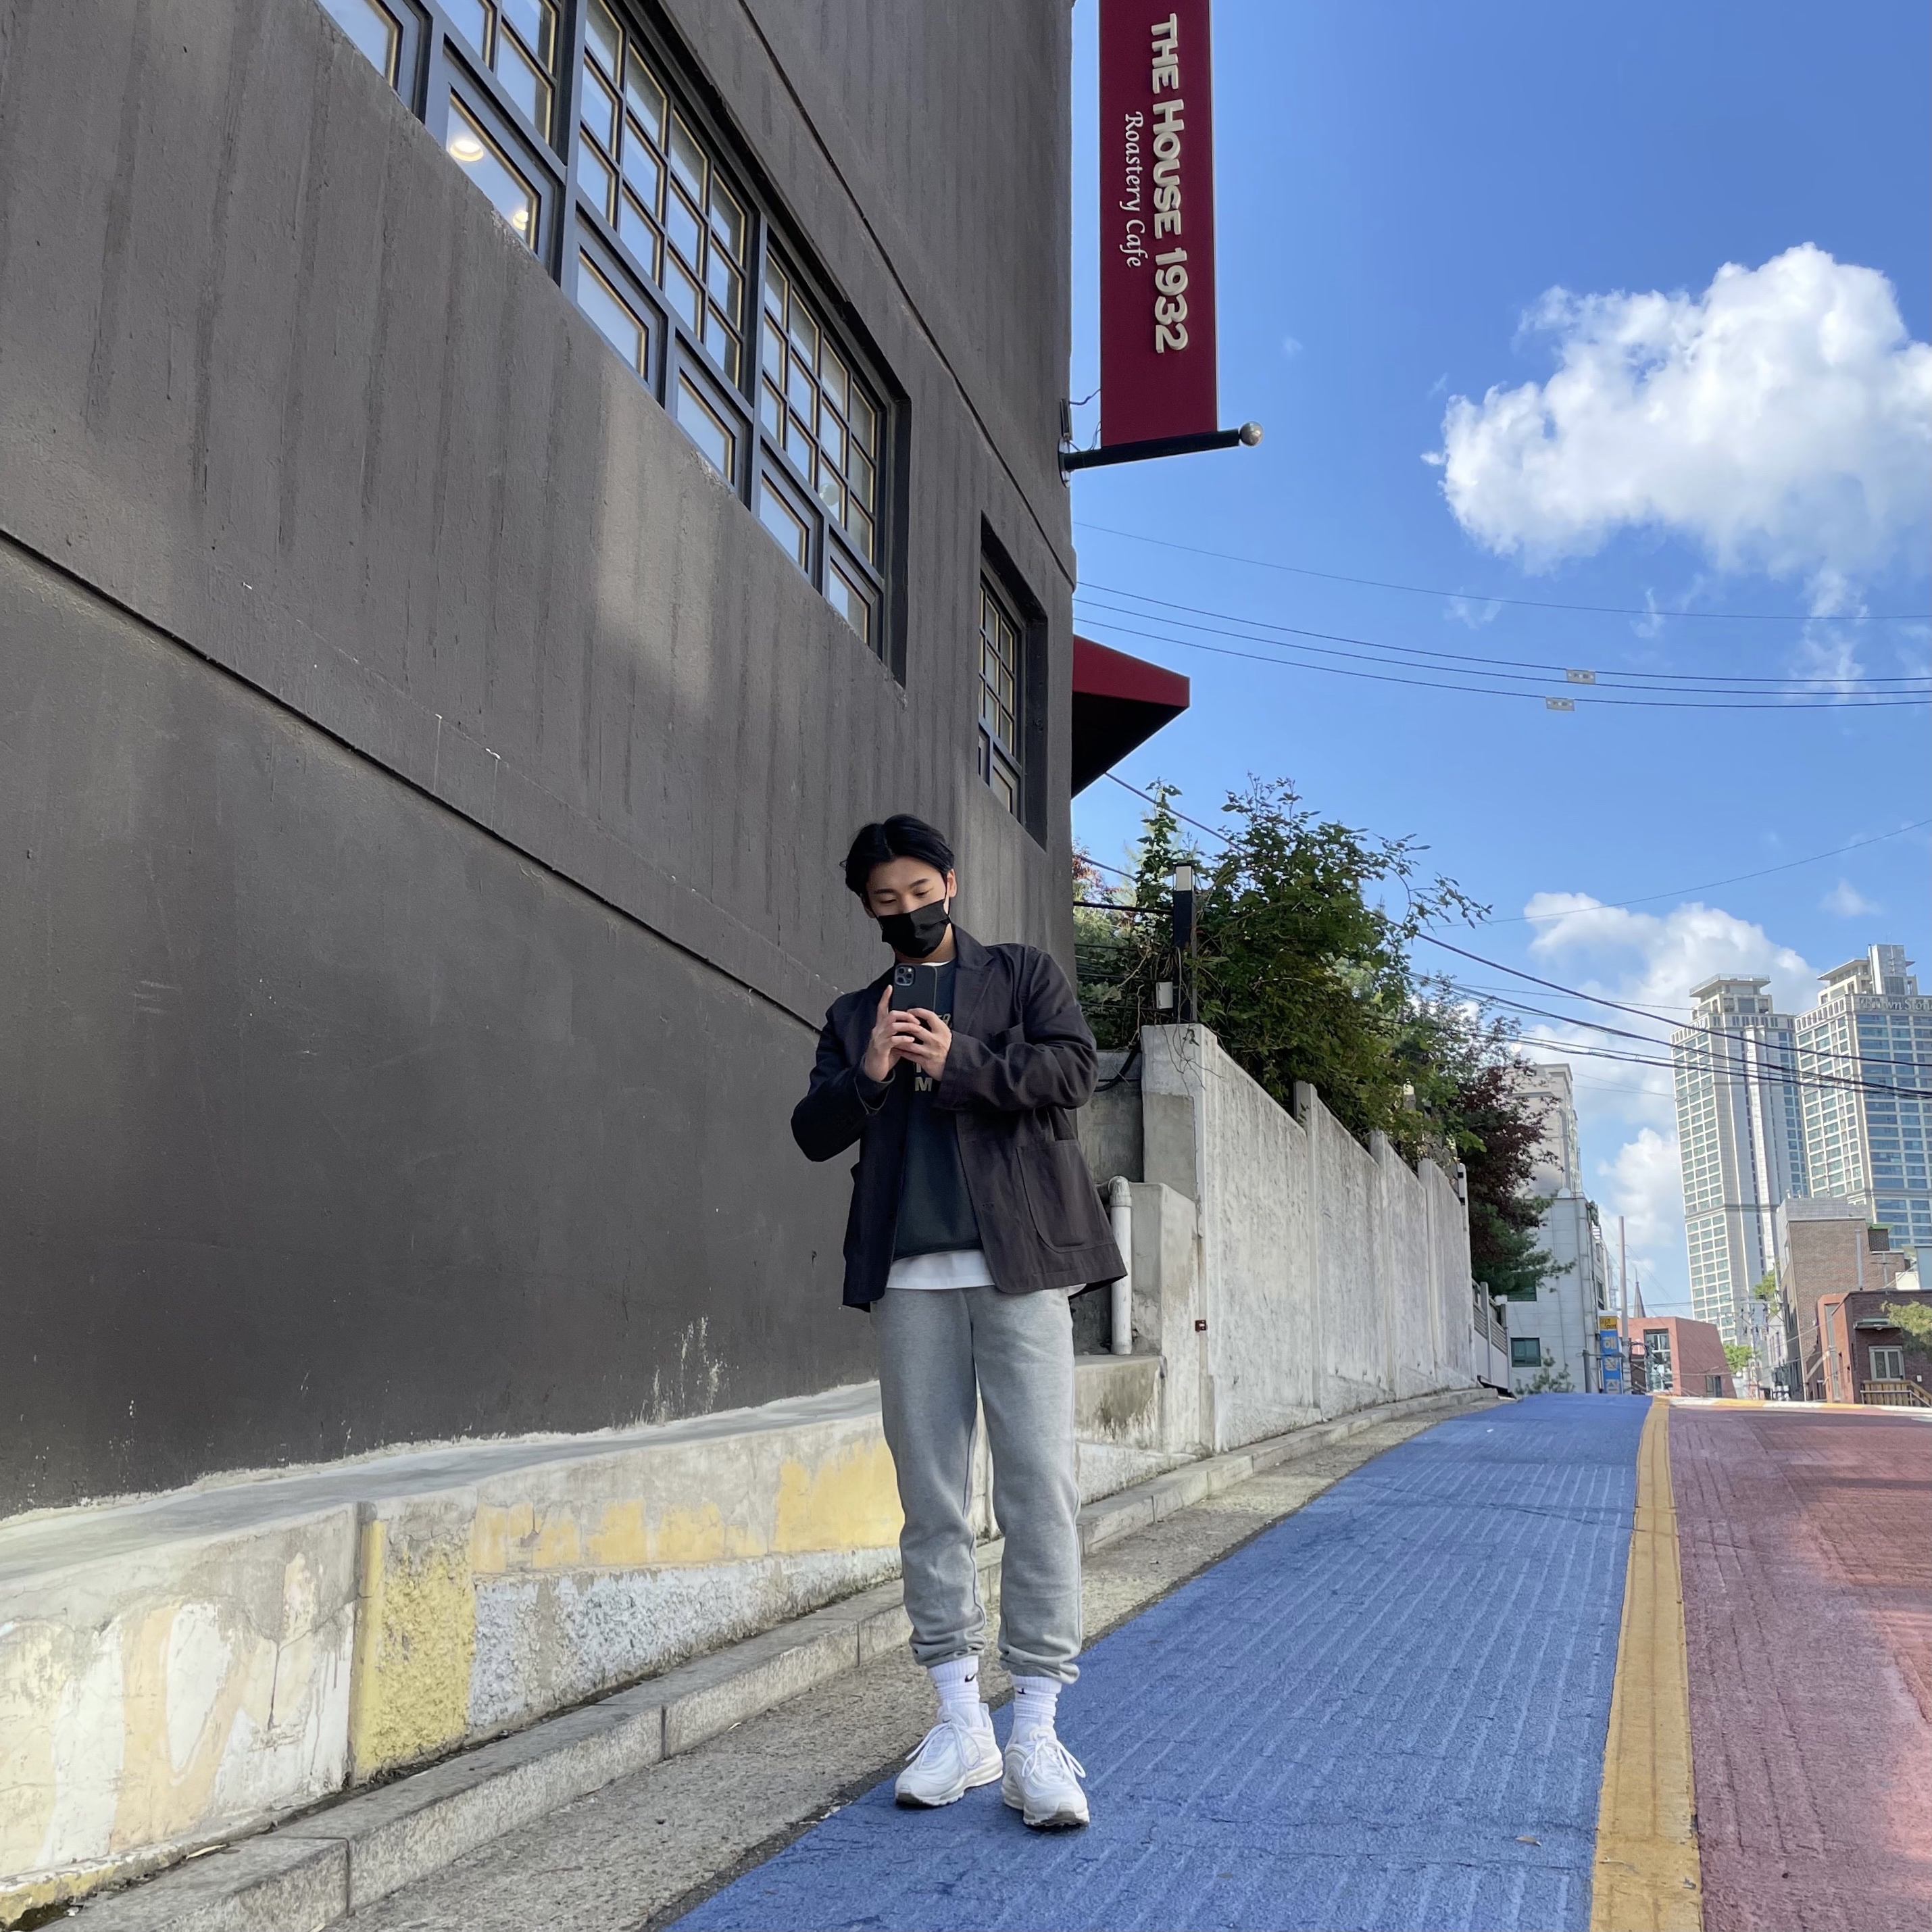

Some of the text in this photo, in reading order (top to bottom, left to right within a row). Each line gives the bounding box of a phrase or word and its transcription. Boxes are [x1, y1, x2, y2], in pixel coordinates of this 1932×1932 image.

[1119, 111, 1149, 268] Roastery Cafe
[1151, 13, 1188, 353] THE HOUSE 1932
[1904, 998, 1932, 1011] Ston
